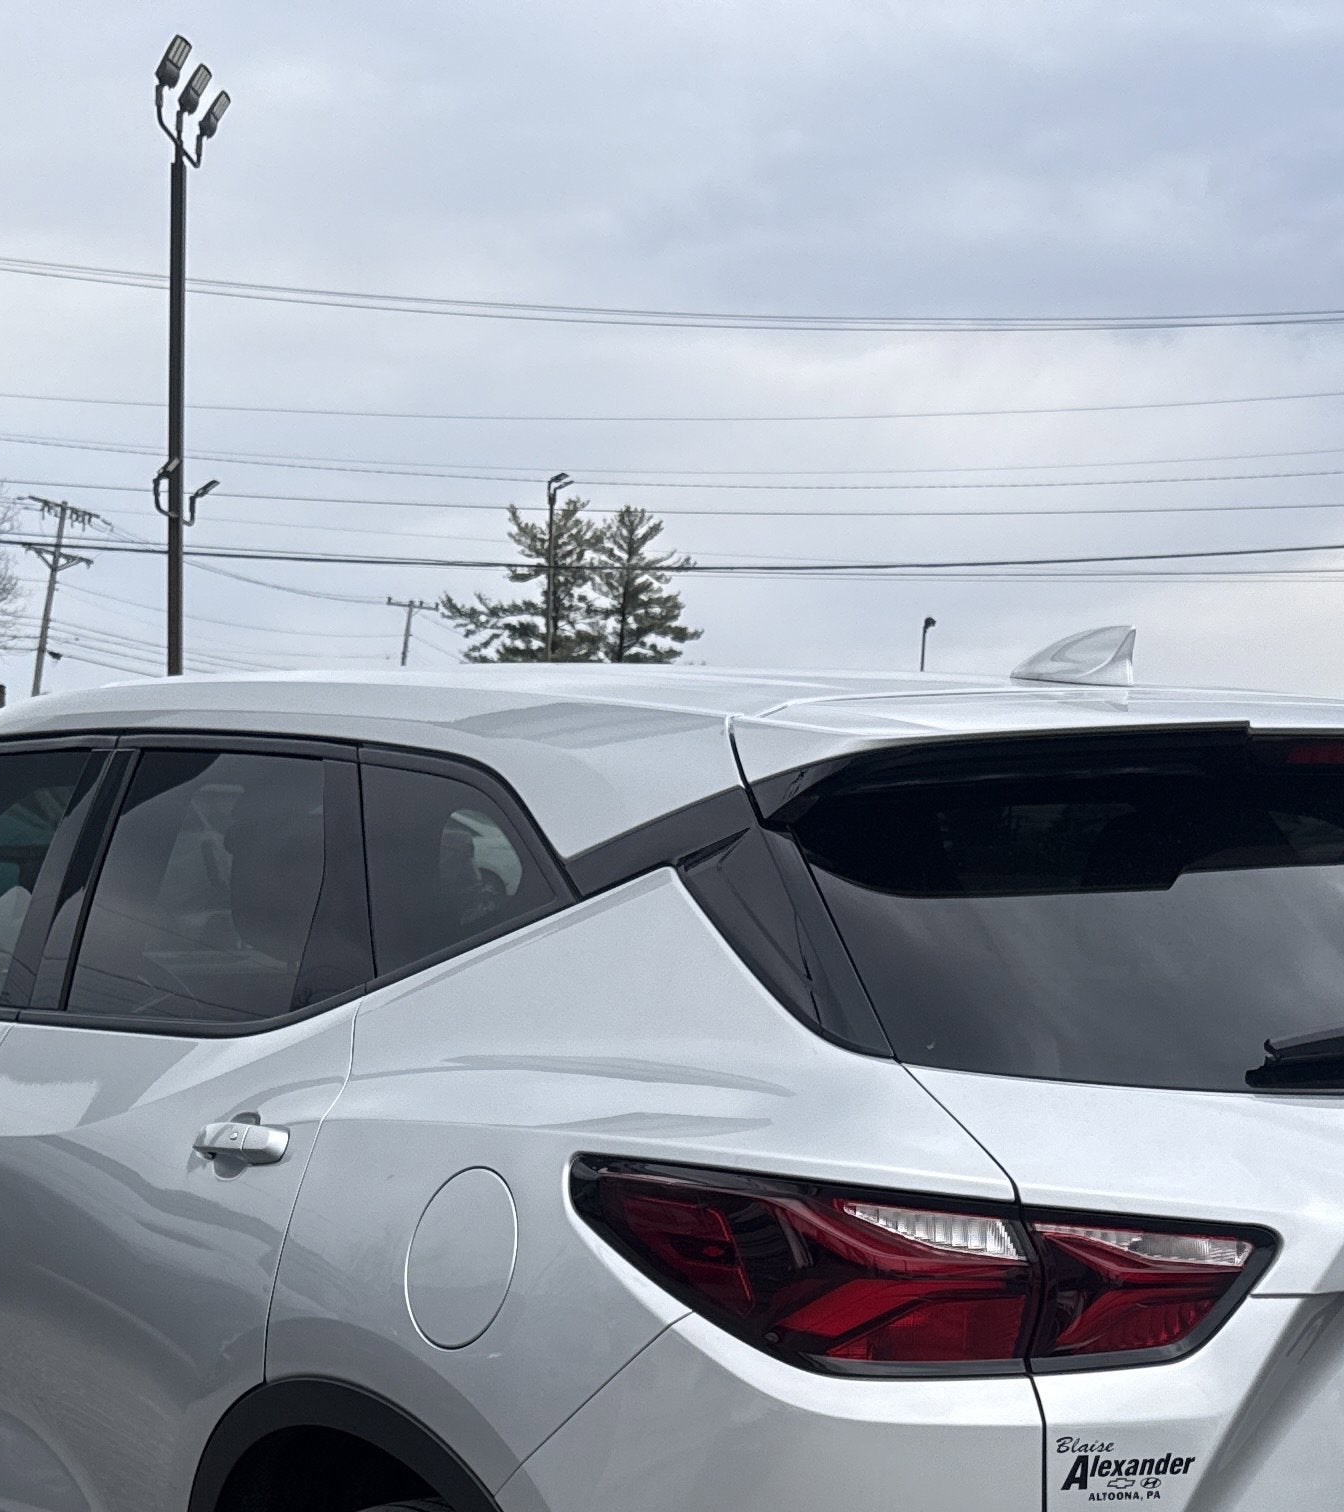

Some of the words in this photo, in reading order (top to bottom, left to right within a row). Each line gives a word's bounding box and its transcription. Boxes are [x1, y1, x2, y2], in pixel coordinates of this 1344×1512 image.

[1056, 1436, 1115, 1454] Blaise
[1060, 1452, 1196, 1491] Alexander
[1088, 1491, 1144, 1502] ALTOONA,
[1146, 1491, 1161, 1500] PA
